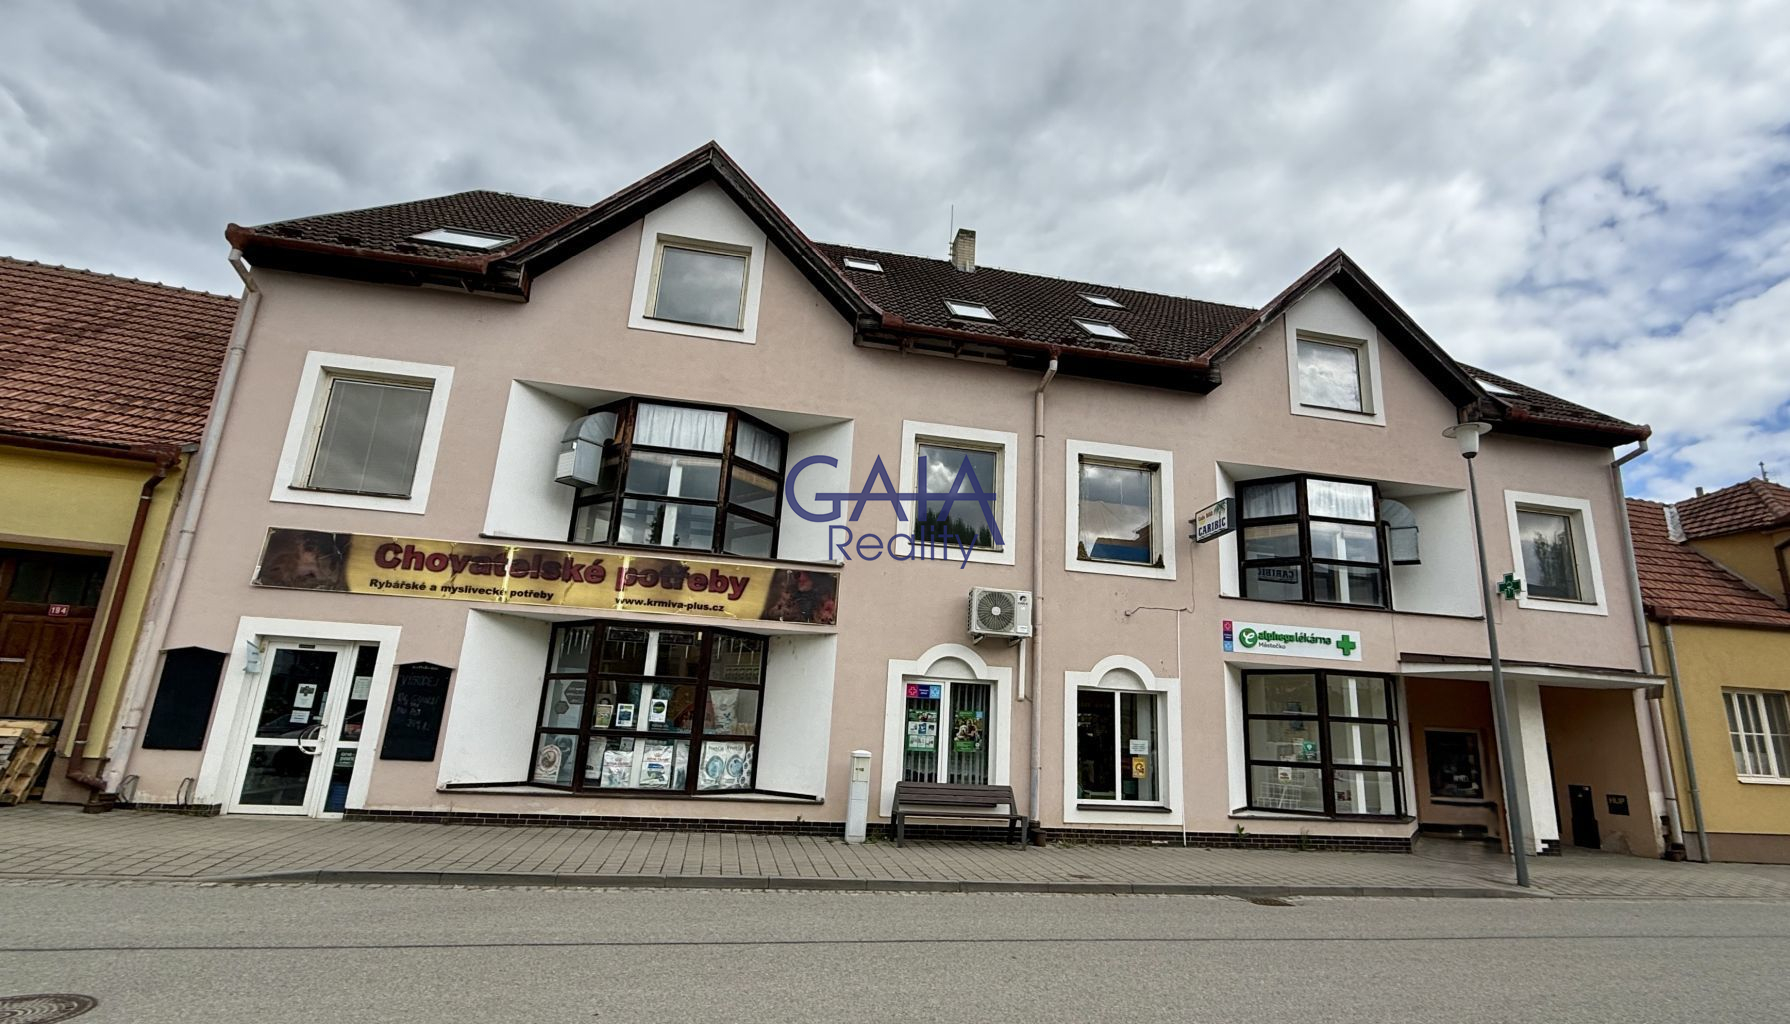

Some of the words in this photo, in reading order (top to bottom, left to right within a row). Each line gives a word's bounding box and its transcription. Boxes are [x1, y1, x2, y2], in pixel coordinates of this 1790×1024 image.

[1198, 517, 1226, 537] CARIBIC
[375, 542, 606, 584] Chovatelské
[615, 564, 750, 601] potřeby
[369, 578, 426, 590] Rybářské
[429, 584, 437, 592] a
[509, 588, 554, 601] potřeby
[615, 597, 724, 612] www.krmiva-plus.cz
[1295, 632, 1332, 645] lékárna
